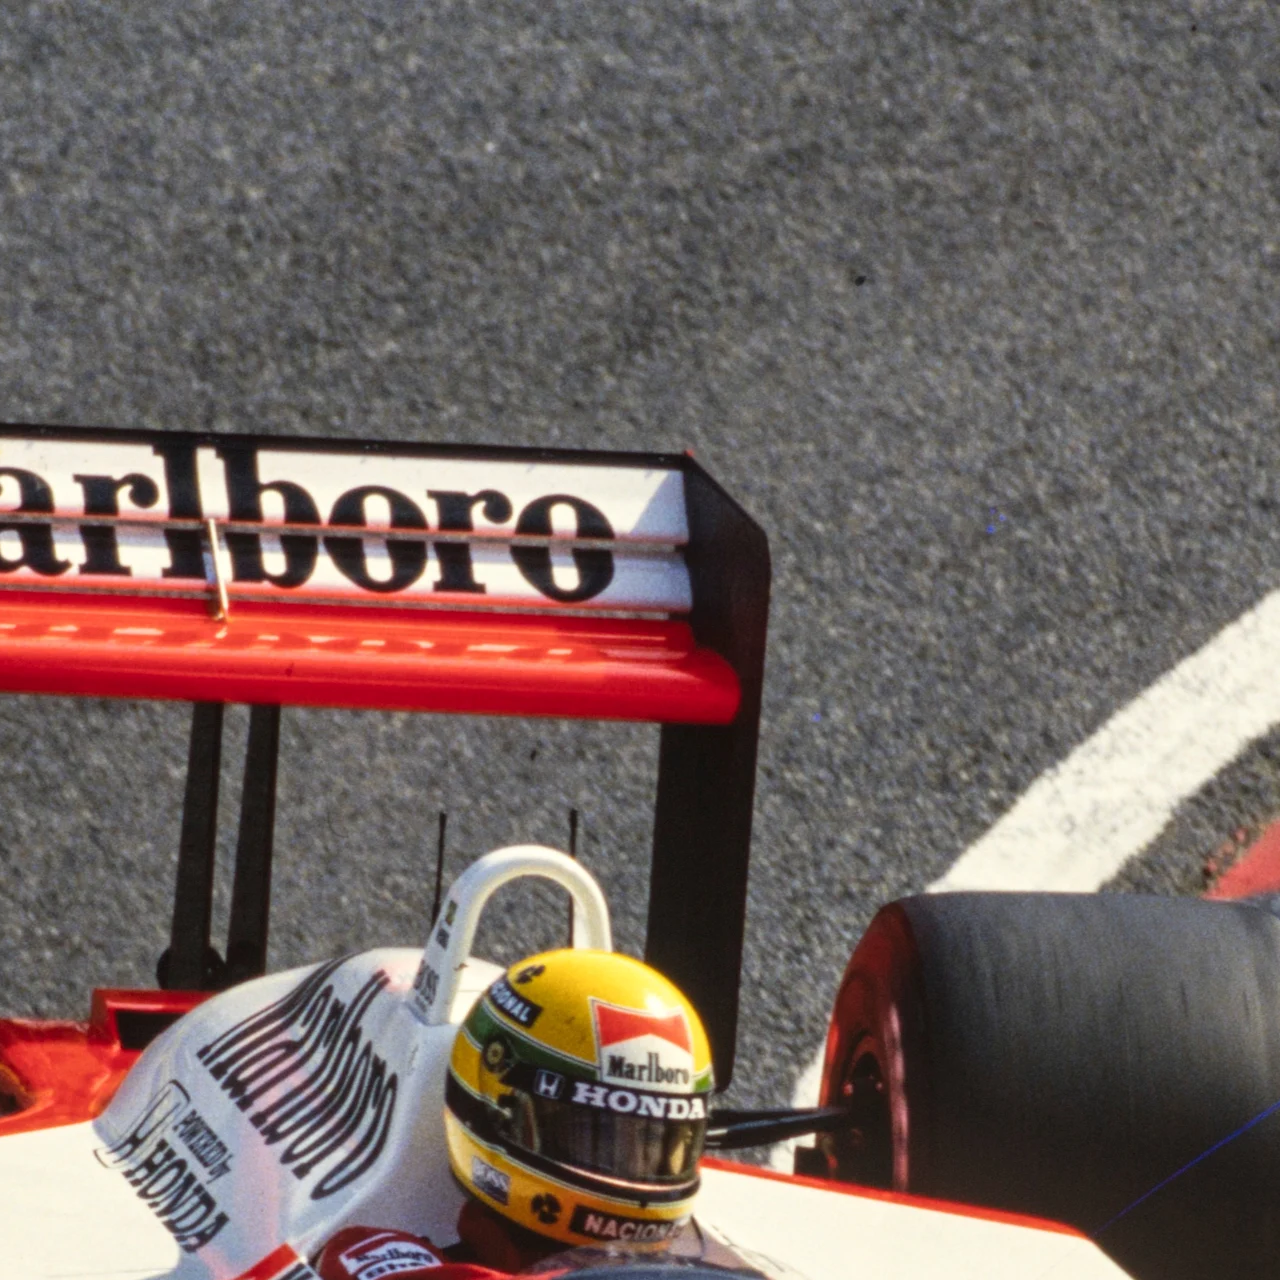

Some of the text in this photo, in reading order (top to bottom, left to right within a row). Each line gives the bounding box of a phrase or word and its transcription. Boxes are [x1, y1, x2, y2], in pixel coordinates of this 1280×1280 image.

[197, 954, 398, 1200] Marlboro
[572, 1081, 707, 1120] HONDA
[607, 1052, 690, 1086] Marlboro
[122, 1138, 231, 1254] HONDA
